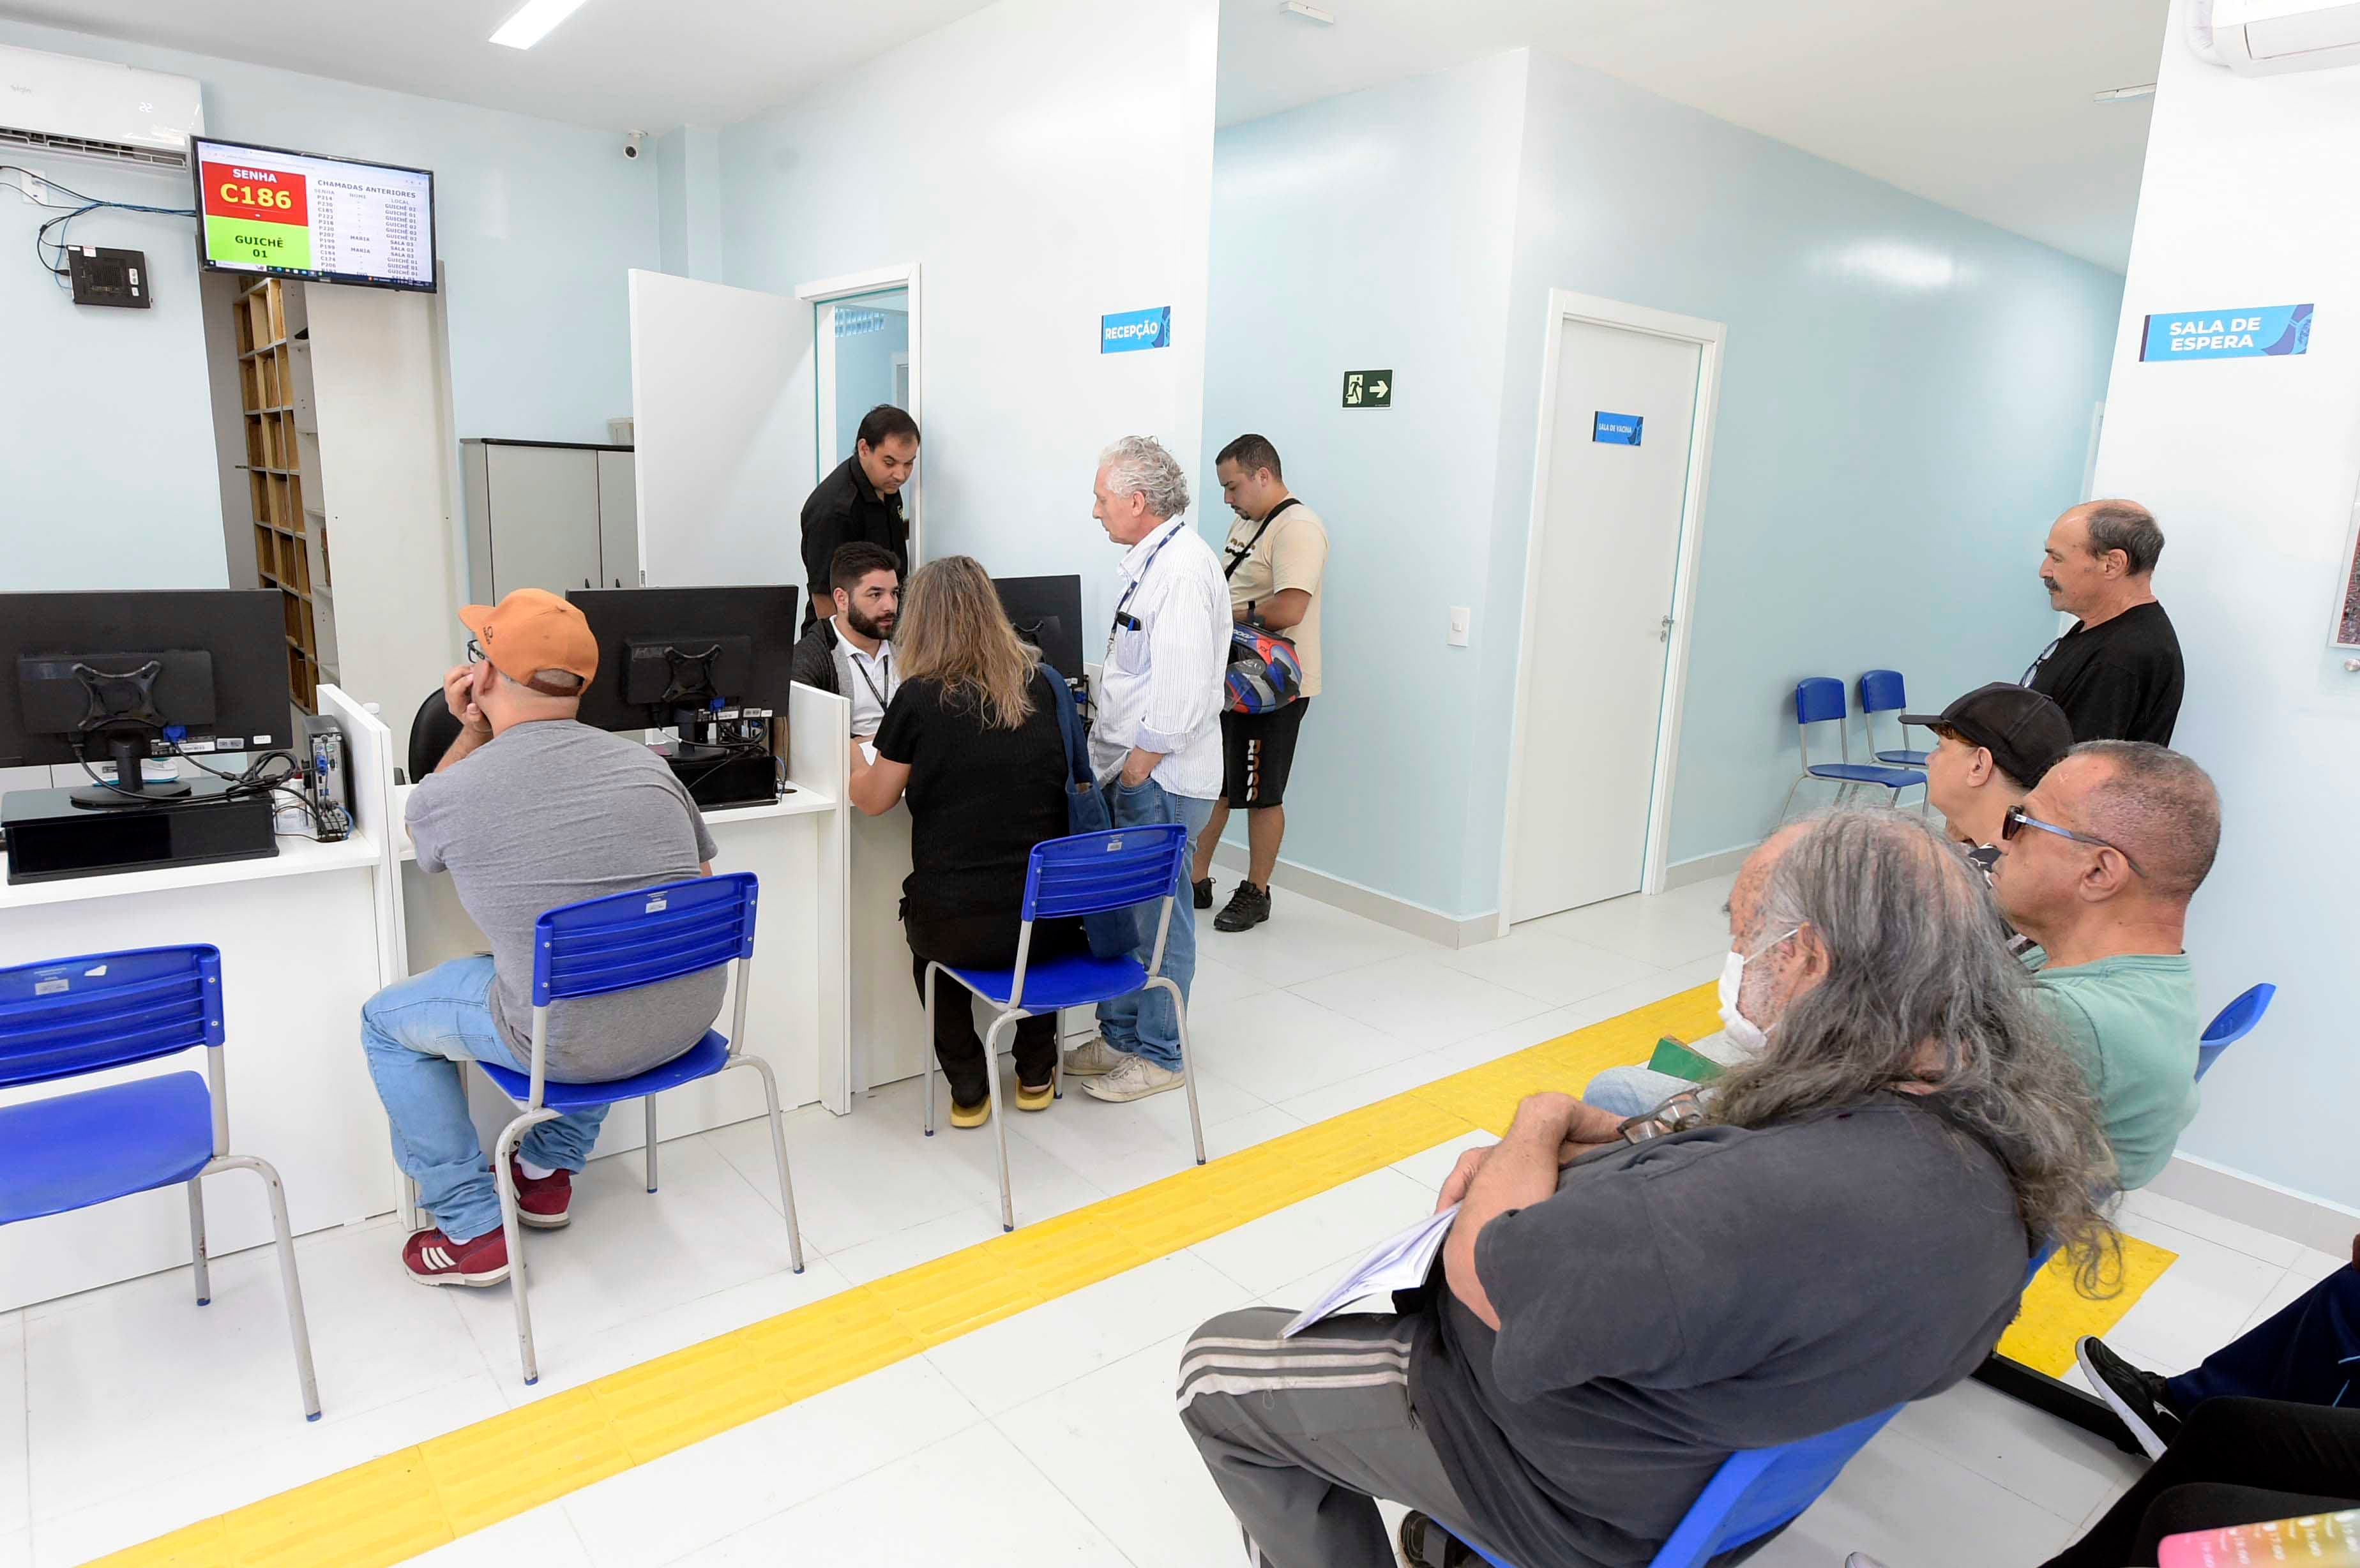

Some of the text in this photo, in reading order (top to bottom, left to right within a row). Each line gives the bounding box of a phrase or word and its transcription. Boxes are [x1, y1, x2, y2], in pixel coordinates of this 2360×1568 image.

[233, 169, 277, 183] SENHA
[220, 183, 292, 209] C186
[318, 180, 416, 198] CHAMADAS ANTERIORES
[253, 249, 268, 258] 01
[1105, 320, 1158, 340] RECEPÇÃO
[2169, 317, 2263, 335] SALA DE
[2170, 334, 2254, 351] ESPERA
